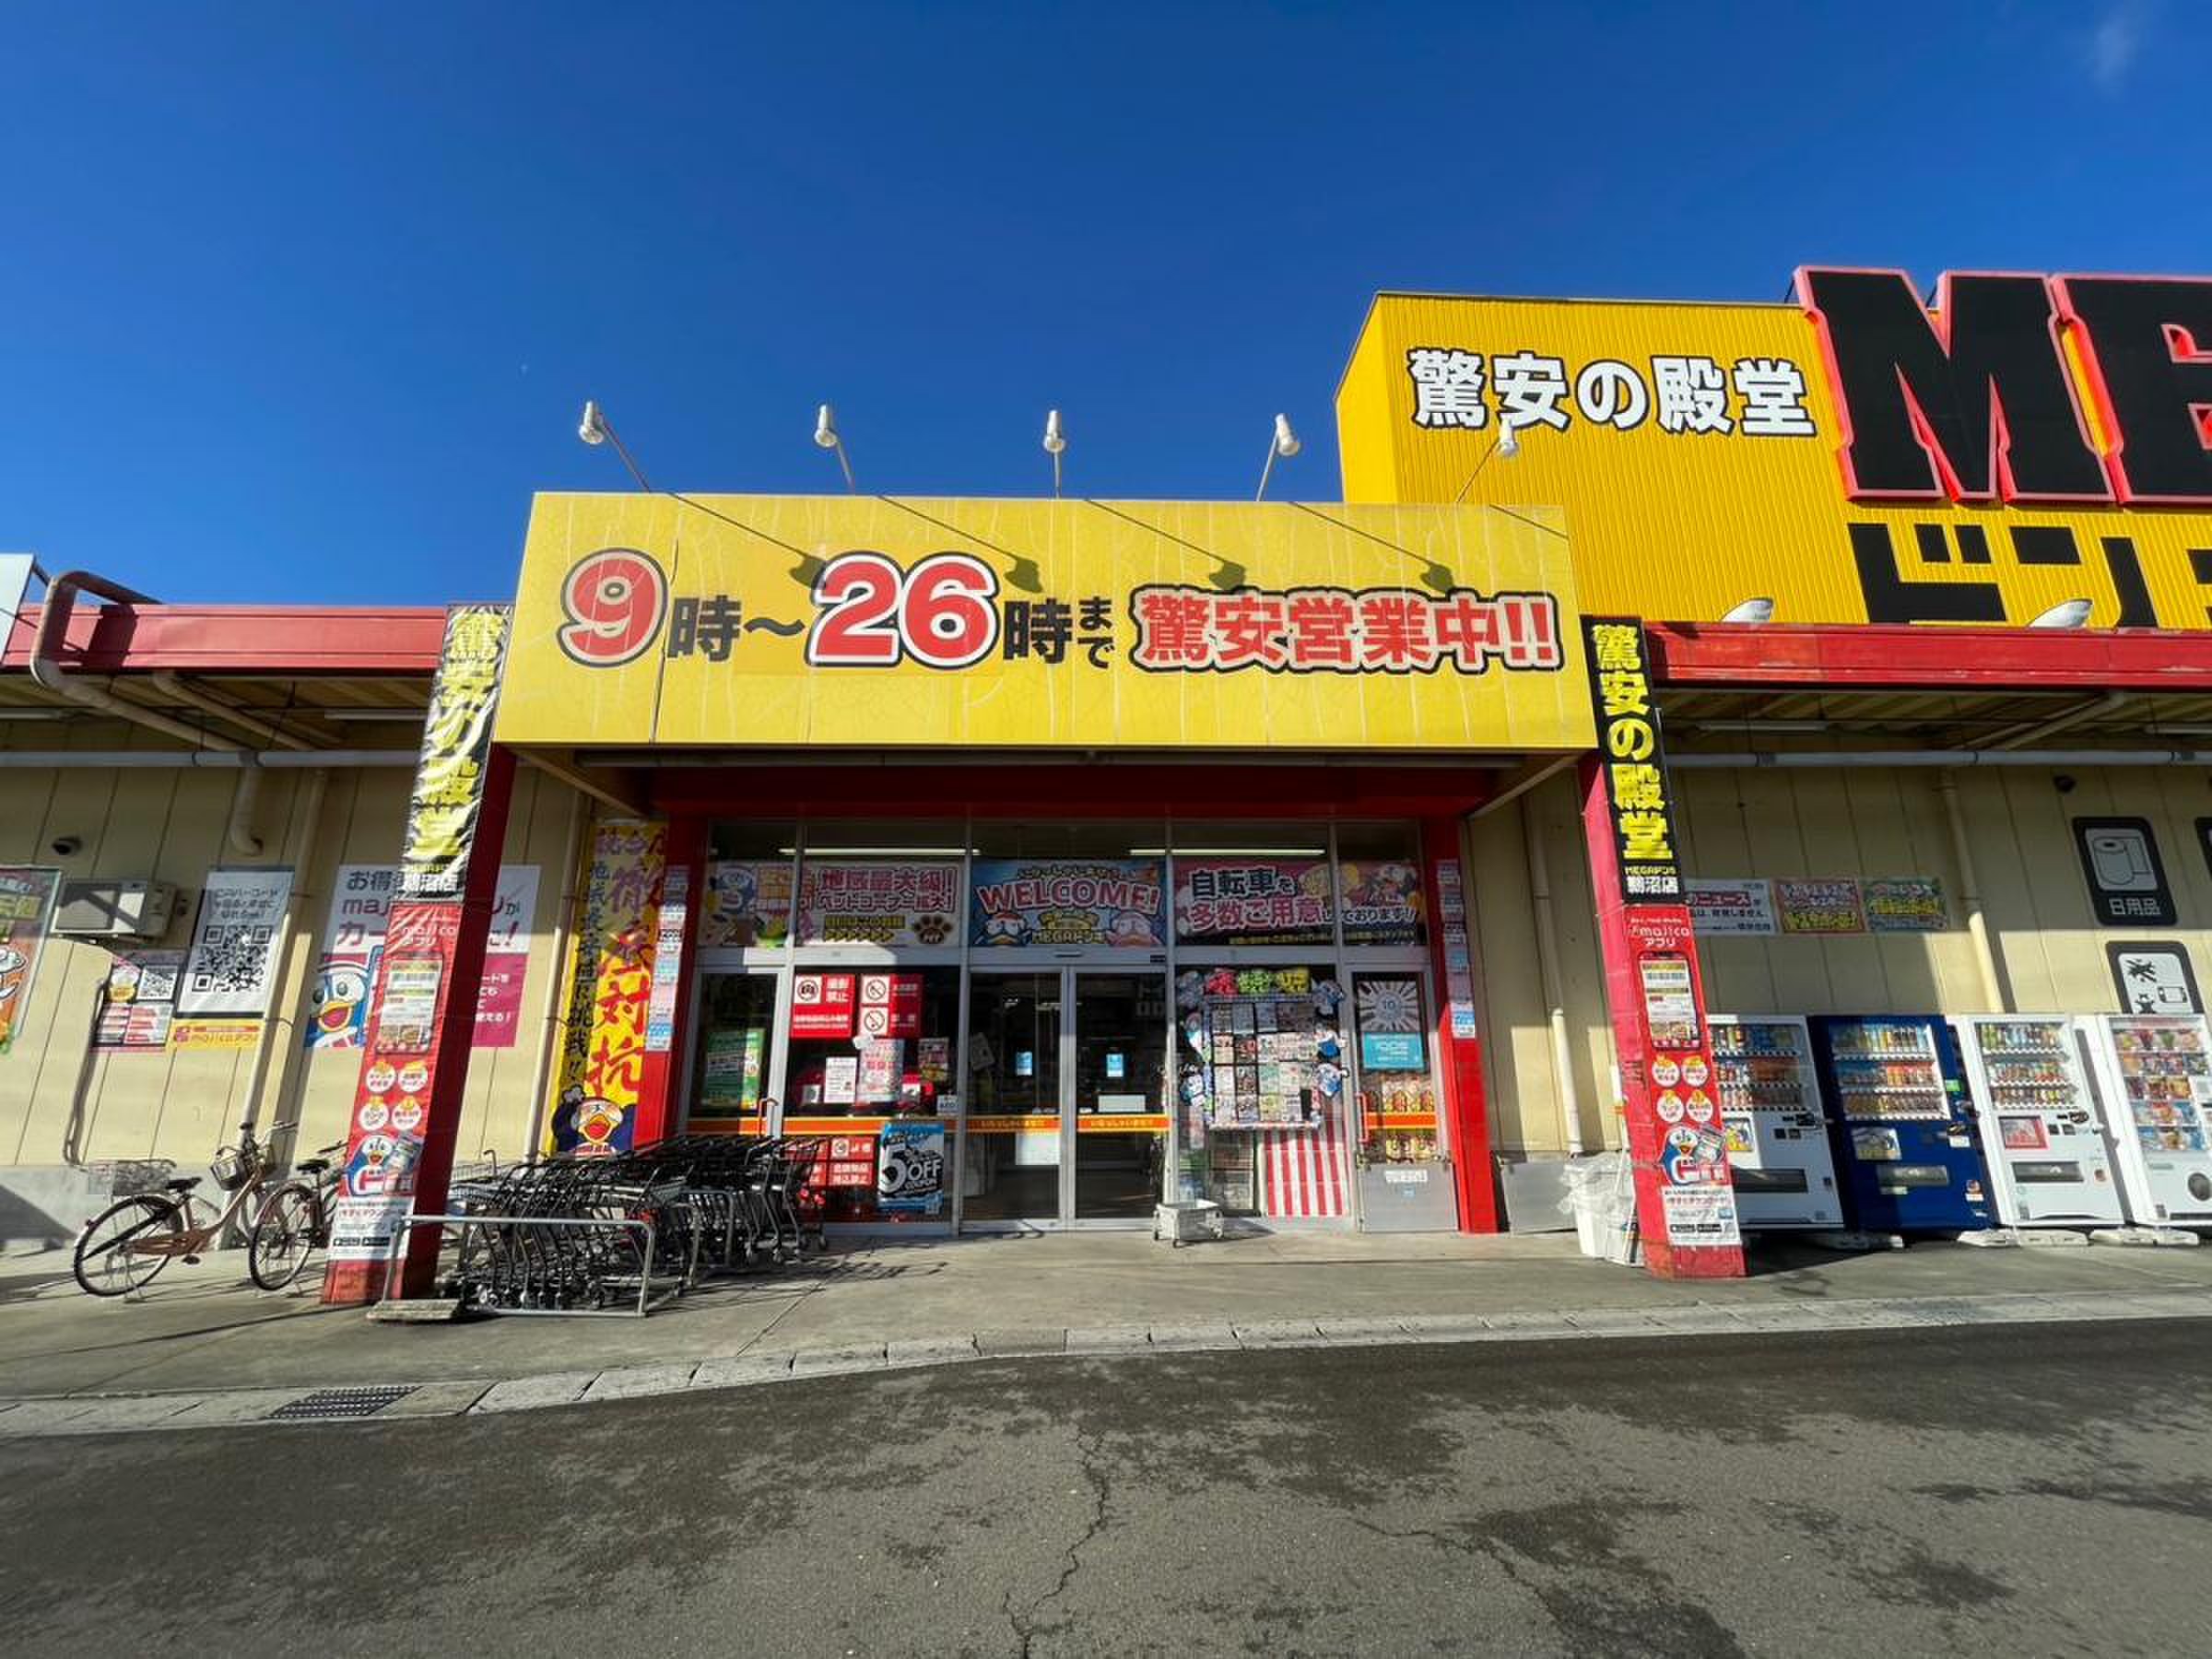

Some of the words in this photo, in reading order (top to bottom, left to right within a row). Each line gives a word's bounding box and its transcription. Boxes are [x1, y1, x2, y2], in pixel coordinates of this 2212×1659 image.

[1407, 347, 1818, 438] 驚安の殿堂
[1131, 586, 1563, 671] 驚安営業中!!
[1593, 624, 1674, 860] 驚安の殿堂
[976, 877, 1160, 915] WELCOME!
[1191, 866, 1300, 900] 自転車を
[2109, 897, 2161, 915] 日用品
[908, 1159, 941, 1181] OFF
